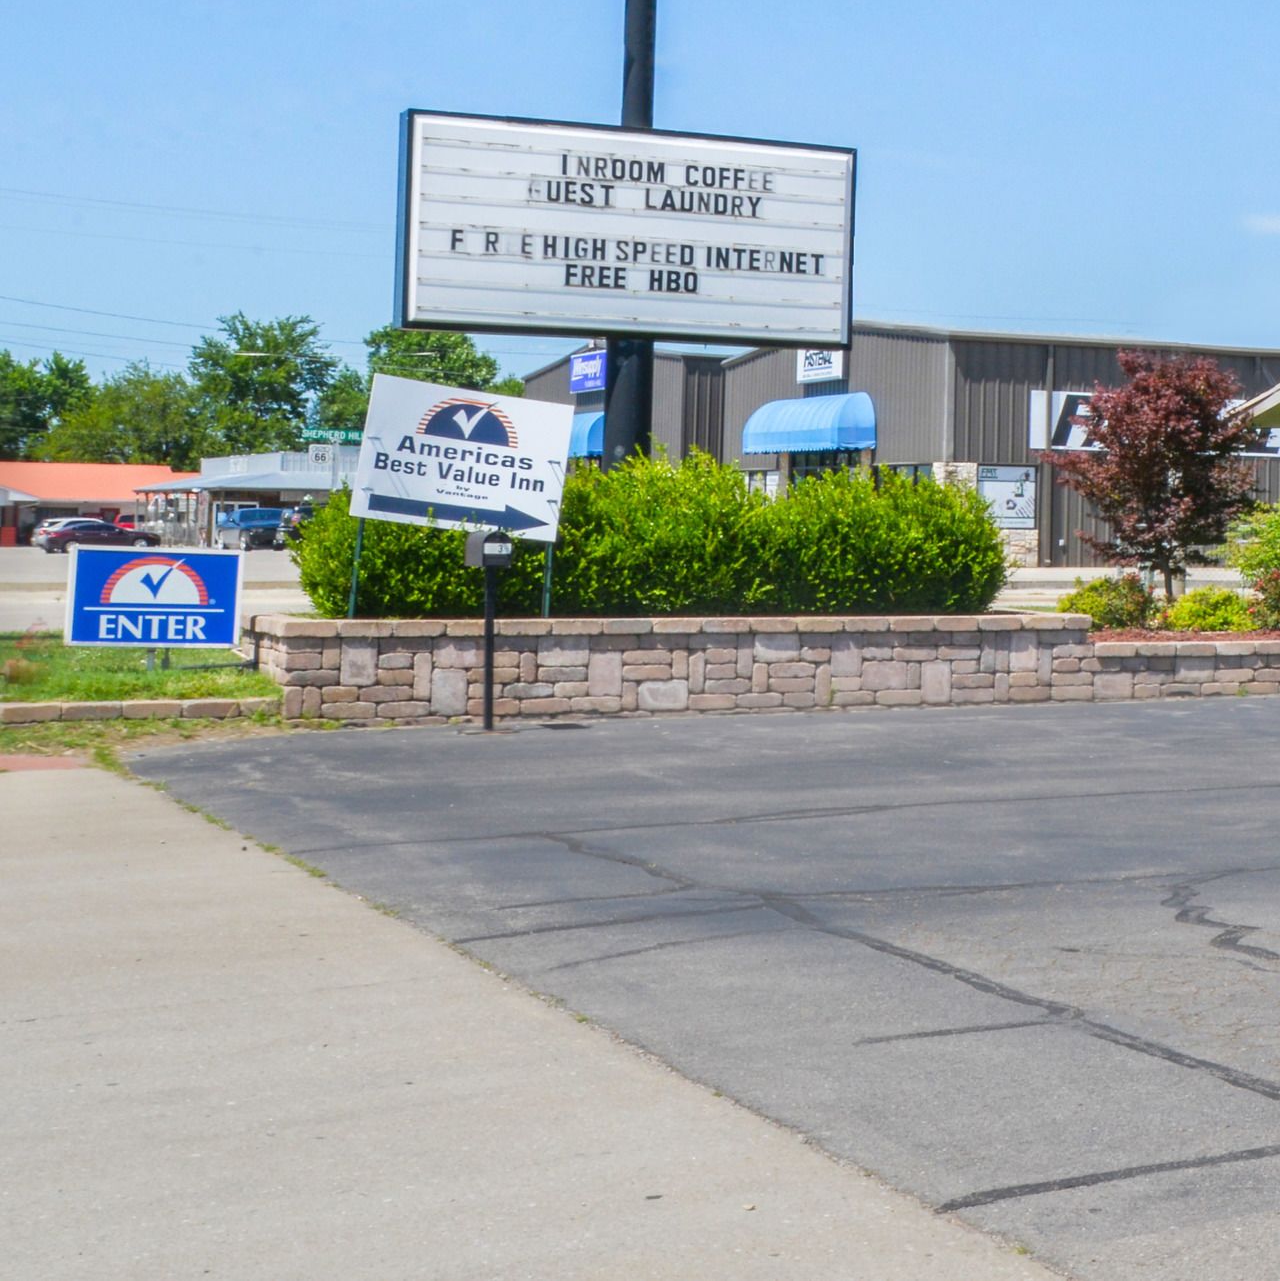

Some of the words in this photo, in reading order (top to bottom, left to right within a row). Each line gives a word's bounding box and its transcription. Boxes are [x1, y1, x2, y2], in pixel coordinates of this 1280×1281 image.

[685, 164, 773, 192] COFFEE
[645, 188, 762, 217] LAUNDRY
[544, 235, 606, 261] HIGH
[616, 240, 694, 266] SPEED
[706, 246, 825, 275] INTERNET
[565, 264, 627, 289] FREE
[650, 269, 698, 293] HBO
[301, 429, 346, 440] SHEPHERD
[314, 452, 327, 462] 66
[397, 435, 533, 470] Americas
[374, 452, 427, 477] Best
[438, 462, 500, 487] Value
[511, 472, 545, 492] Inn
[436, 488, 489, 500] Vantage
[98, 614, 207, 640] ENTER
